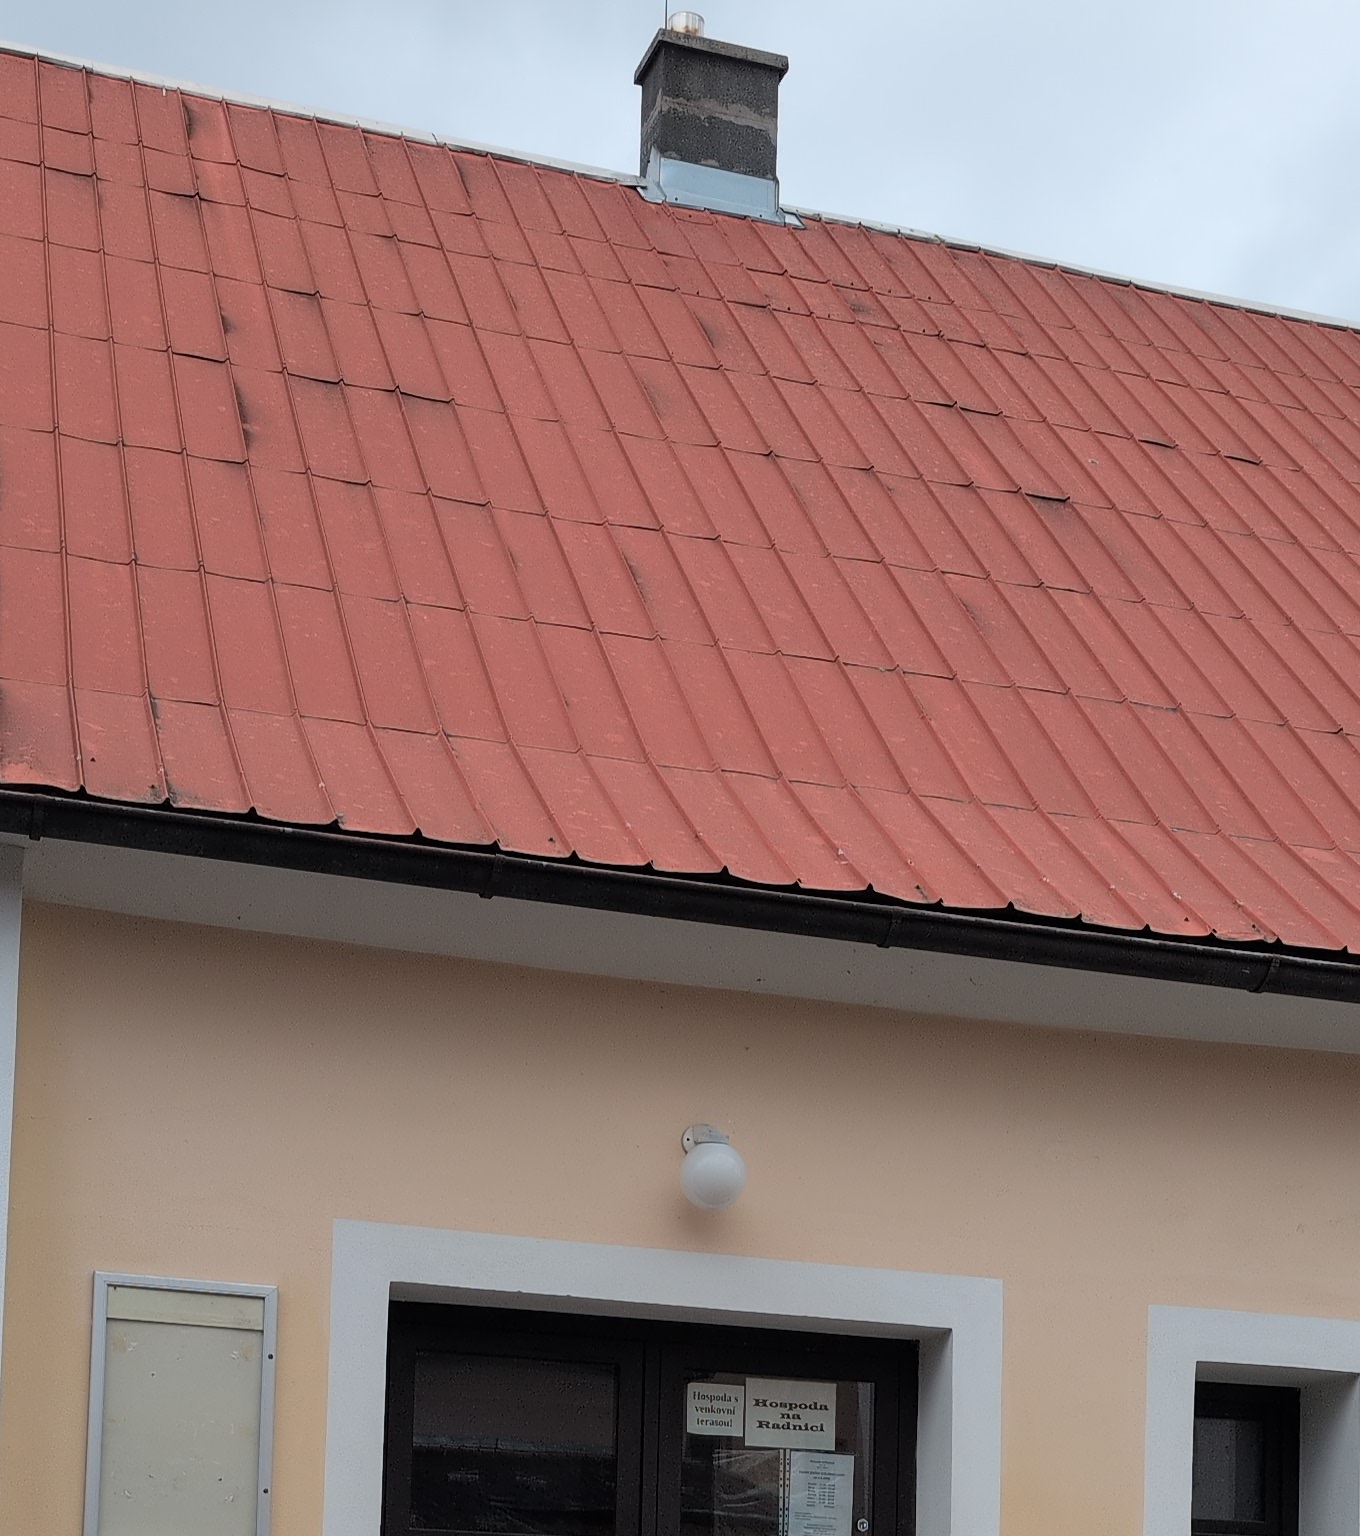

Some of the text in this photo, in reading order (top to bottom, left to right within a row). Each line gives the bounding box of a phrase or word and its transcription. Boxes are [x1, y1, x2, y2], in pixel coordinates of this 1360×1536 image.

[693, 1391, 732, 1403] Hospoda
[694, 1404, 736, 1416] venkovní
[753, 1398, 829, 1411] Hospoda
[780, 1412, 801, 1420] na
[697, 1417, 733, 1428] terasou!
[756, 1420, 825, 1432] Radnici
